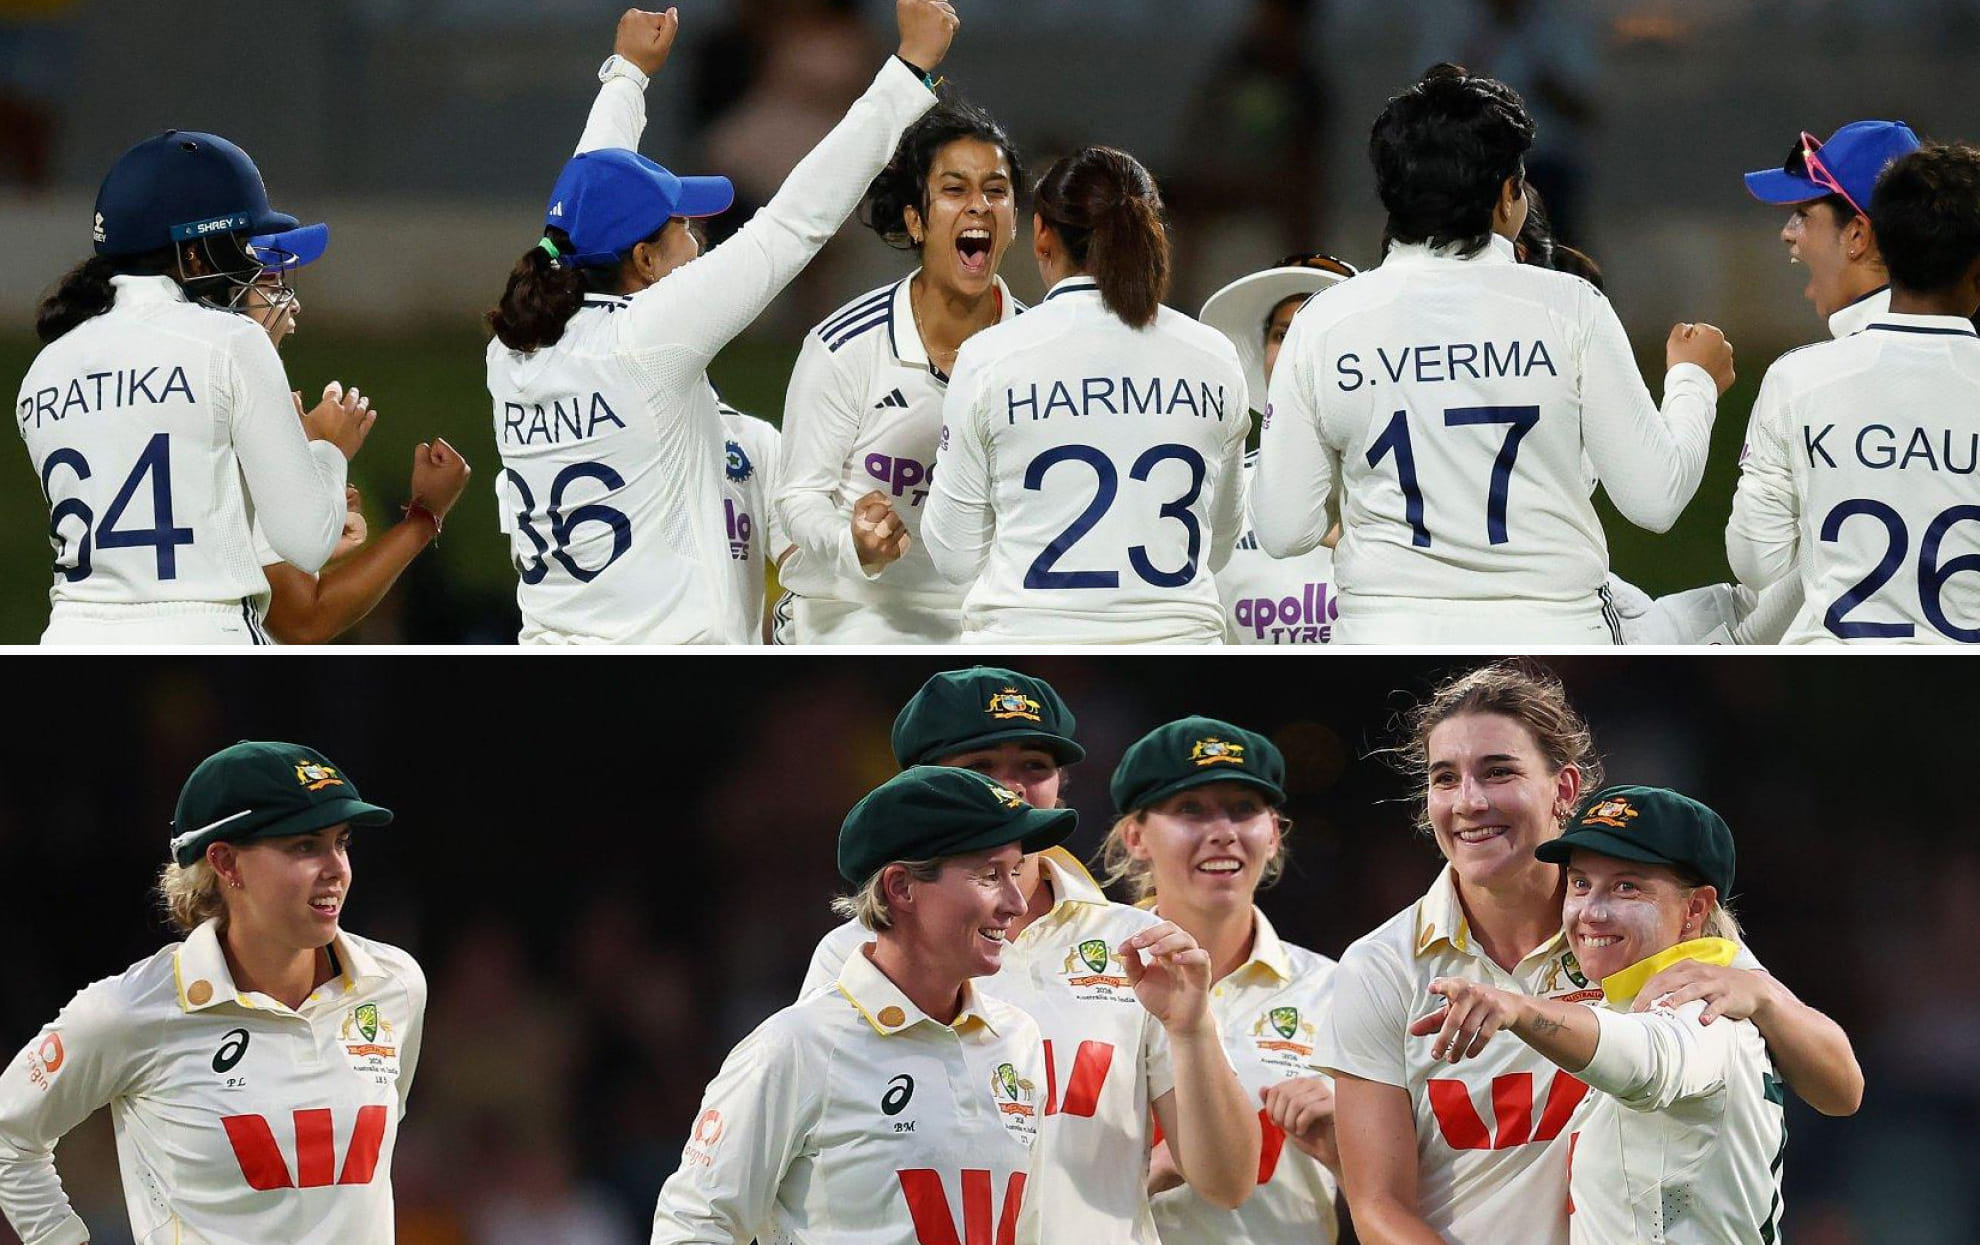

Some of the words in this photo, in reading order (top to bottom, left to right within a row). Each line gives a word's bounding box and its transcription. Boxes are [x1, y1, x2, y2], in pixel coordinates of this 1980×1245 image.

[197, 218, 233, 234] SHREY
[1336, 340, 1558, 392] S.VERMA
[20, 366, 196, 433] PRATIKA
[503, 391, 627, 446] RANA
[1006, 376, 1225, 425] HARMAN
[1365, 404, 1541, 549] 17
[1803, 424, 1838, 469] K
[1855, 424, 1979, 475] GAU
[40, 432, 195, 583] 64
[1023, 443, 1207, 590] 23
[1819, 498, 1980, 644] 26
[27, 1051, 48, 1092] origin
